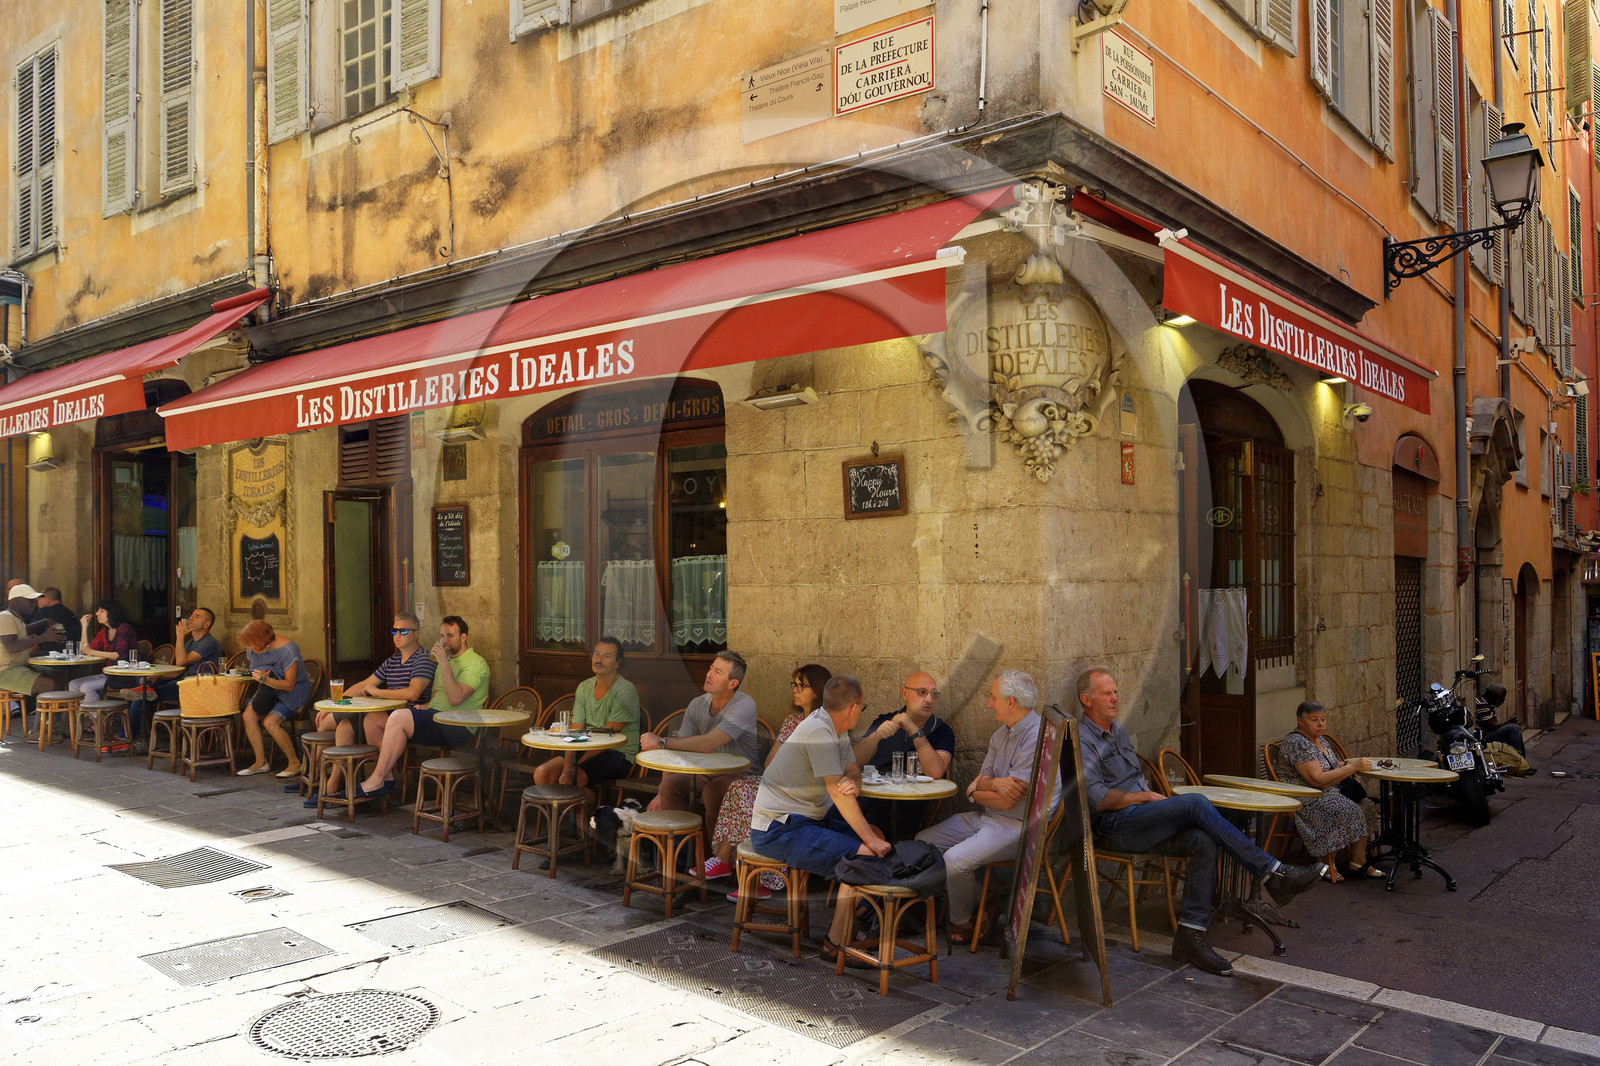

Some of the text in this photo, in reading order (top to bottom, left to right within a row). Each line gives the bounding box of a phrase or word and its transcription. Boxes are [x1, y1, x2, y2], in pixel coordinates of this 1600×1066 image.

[841, 39, 929, 75] DE LA PREFECTURE
[873, 36, 894, 52] RUE
[1123, 45, 1134, 61] RUE
[760, 72, 776, 82] Vieux
[777, 66, 791, 77] Nice
[856, 64, 912, 89] CARRIERA
[1105, 45, 1152, 87] DE LA POISSONNERIE
[769, 98, 777, 106] du
[777, 93, 794, 104] Cours
[1109, 81, 1149, 116] SAN JAUME
[1111, 69, 1148, 101] CARRIERA
[1024, 303, 1059, 321] LES
[965, 322, 1102, 357] DISTILLERIES
[1219, 283, 1405, 402] LES DISTILLERIES IDEALES
[295, 339, 635, 428] LES DISTILLERIES IDEALES
[52, 393, 105, 426] IDEALES
[547, 395, 720, 434] DETAIL GROS DEMI-GROS
